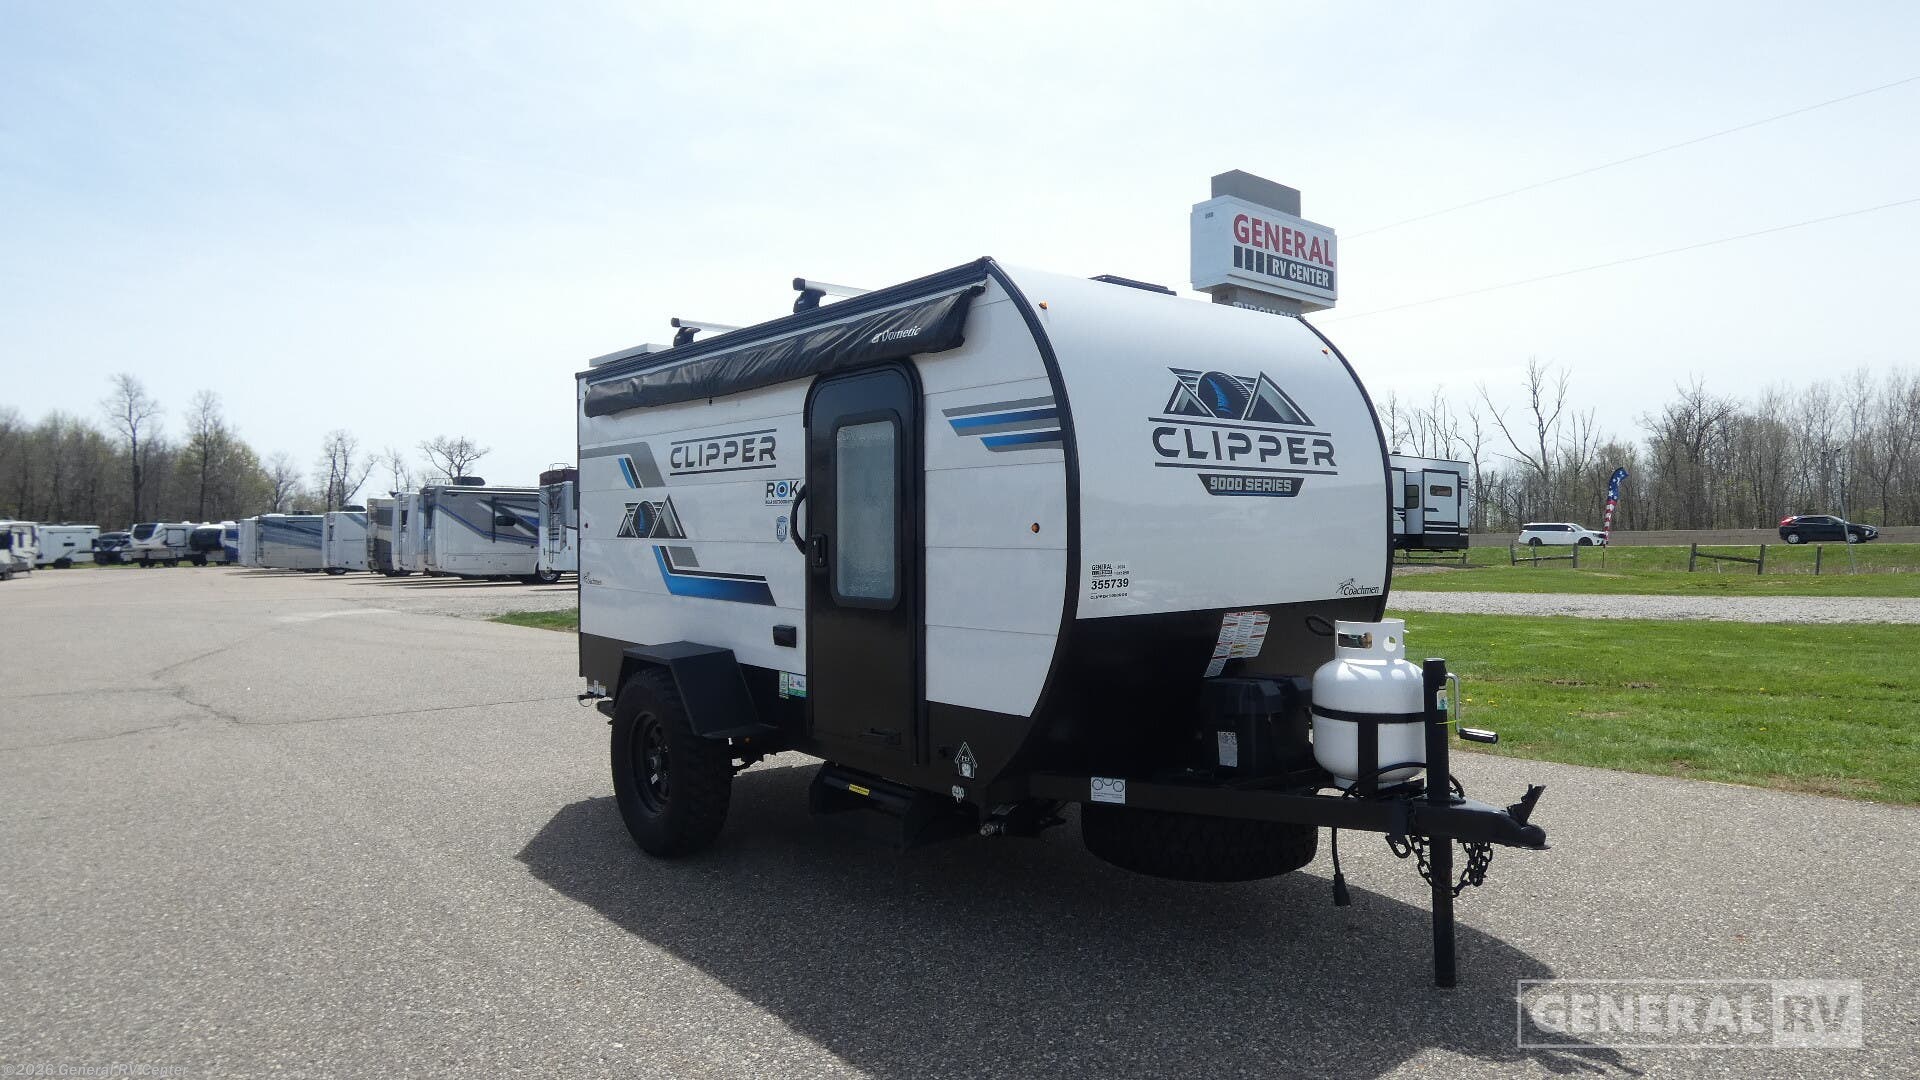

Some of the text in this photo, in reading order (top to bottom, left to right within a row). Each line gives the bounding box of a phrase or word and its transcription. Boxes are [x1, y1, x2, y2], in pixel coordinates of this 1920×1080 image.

[1233, 213, 1334, 267] GENERAL
[1272, 258, 1329, 287] RV CENTER
[670, 436, 777, 469] CLIPPER
[1152, 426, 1337, 467] CLIPPER
[766, 480, 799, 498] ROK
[1210, 476, 1293, 493] 9000 SERIES
[1091, 578, 1129, 590] 355739
[1343, 585, 1380, 596] Coachmen
